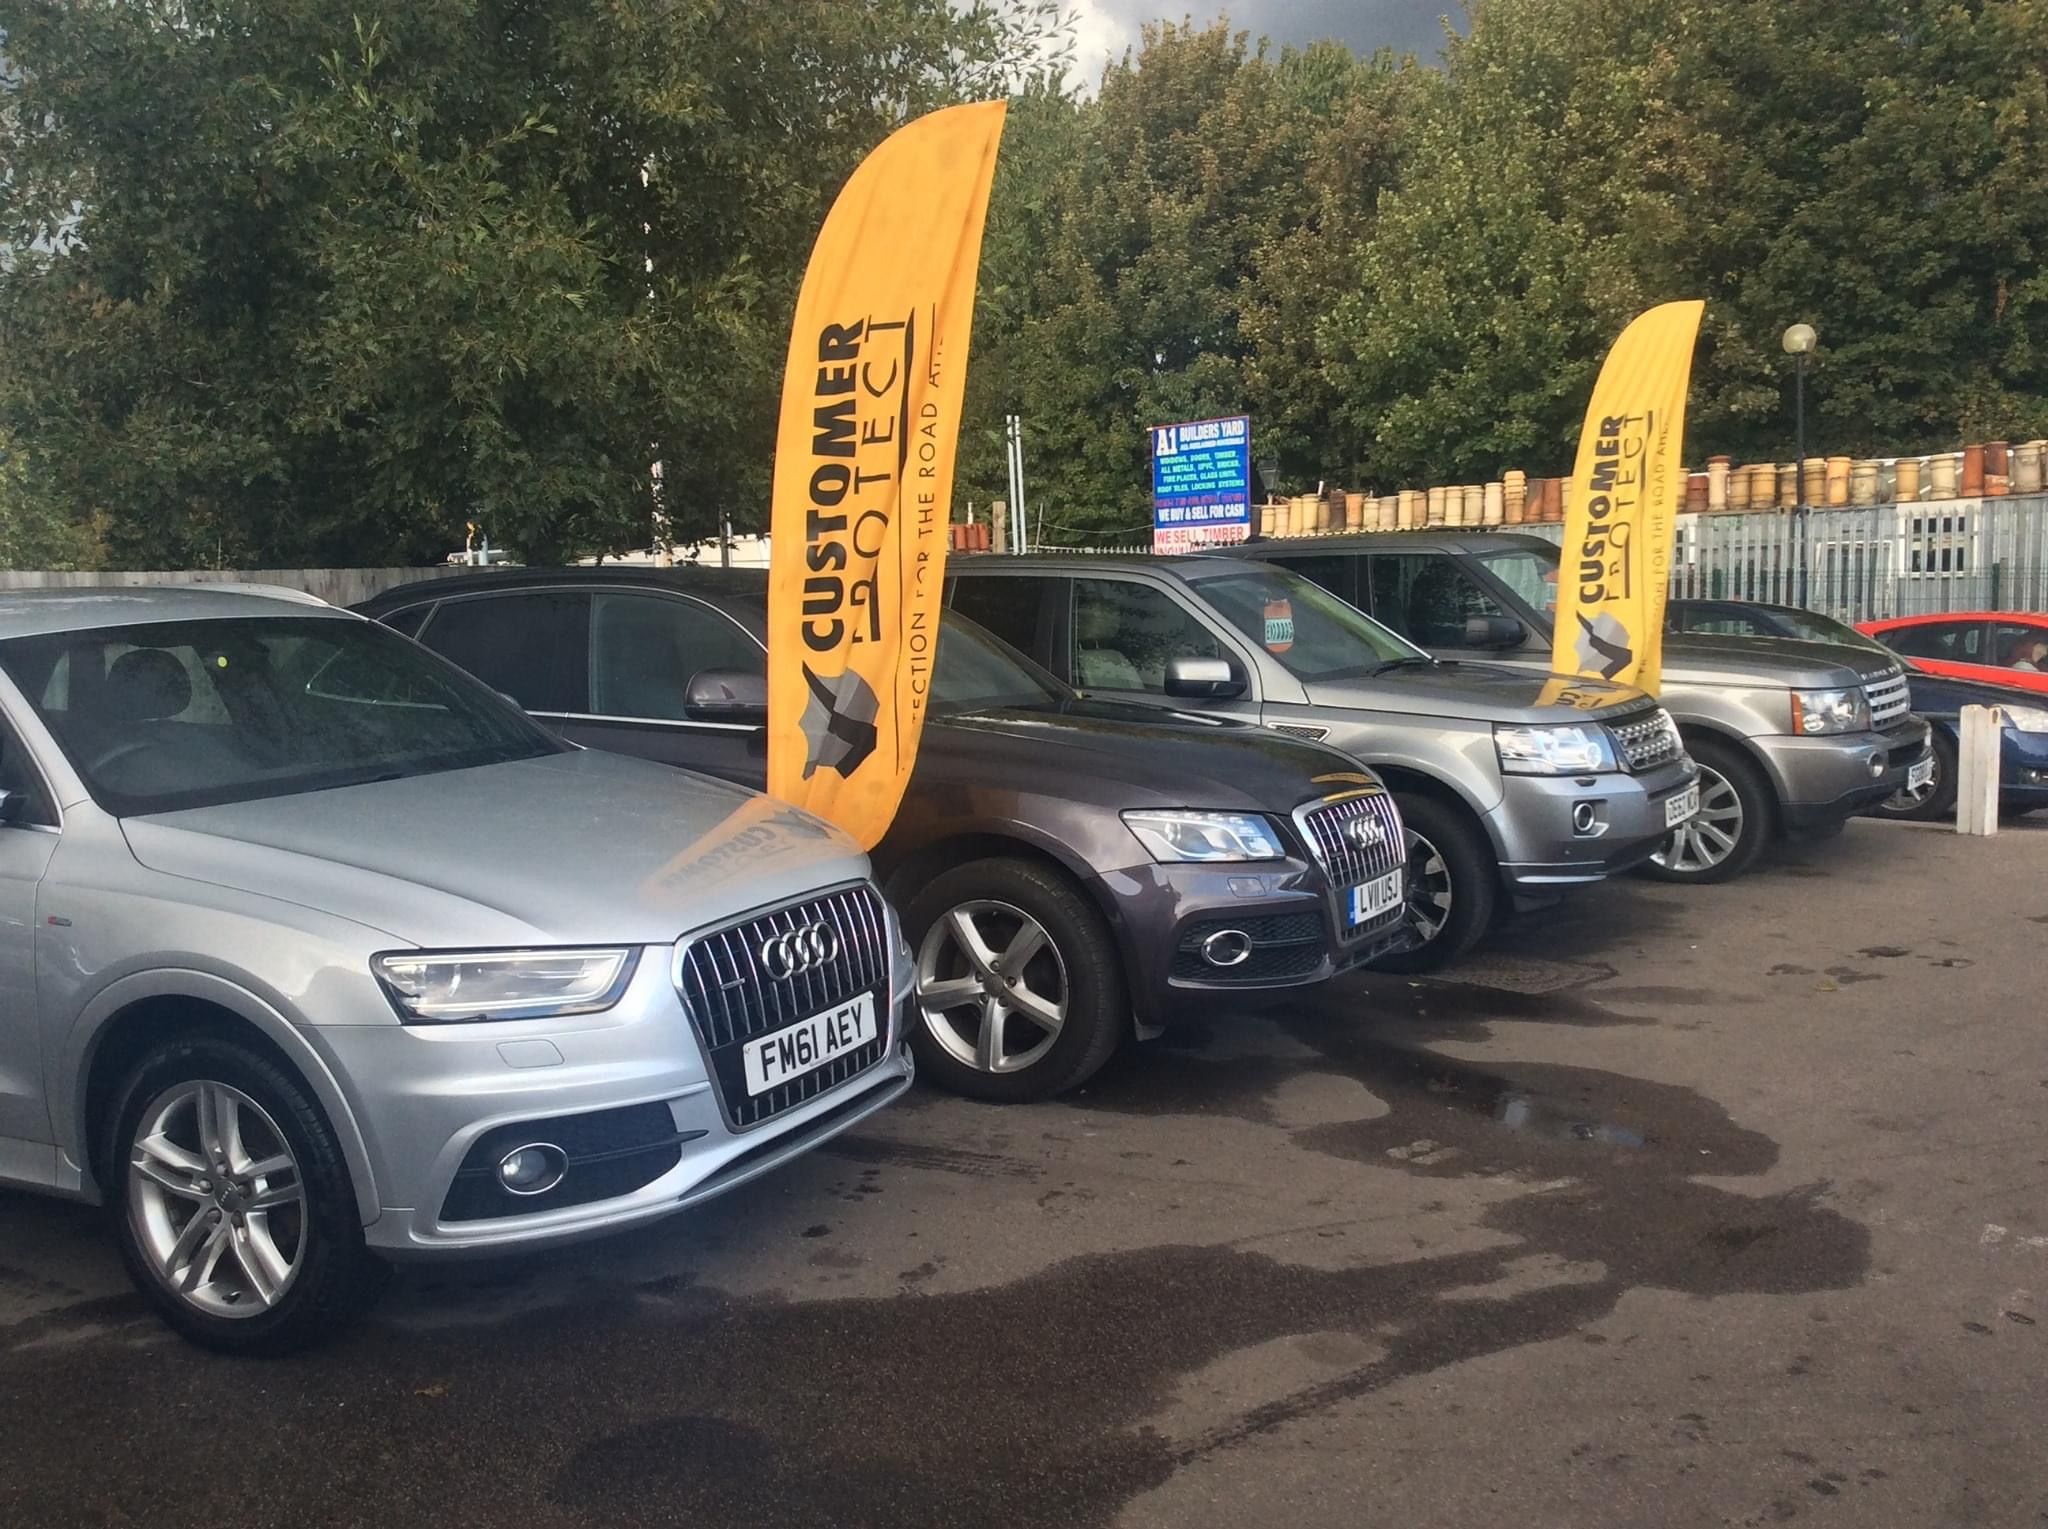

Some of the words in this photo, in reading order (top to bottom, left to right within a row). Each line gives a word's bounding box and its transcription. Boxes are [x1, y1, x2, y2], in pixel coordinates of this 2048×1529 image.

[918, 403, 938, 478] ROAD
[1156, 427, 1178, 457] A1
[1180, 423, 1219, 442] BUILDERS
[1220, 420, 1244, 438] YARD
[802, 318, 864, 652] CUSTOMER
[1158, 508, 1169, 522] WE
[1170, 507, 1184, 521] BUY
[1185, 506, 1191, 520] &
[1191, 505, 1208, 520] SELL
[1209, 504, 1224, 519] FOR
[1225, 503, 1245, 518] CASH
[1579, 413, 1624, 604] CUSTOMER
[918, 493, 934, 539] THE
[1156, 531, 1171, 545] WE
[1174, 528, 1198, 544] SELL
[1202, 526, 1244, 542] TIMBER
[760, 1023, 819, 1082] FM61
[826, 1002, 862, 1054] AEY
